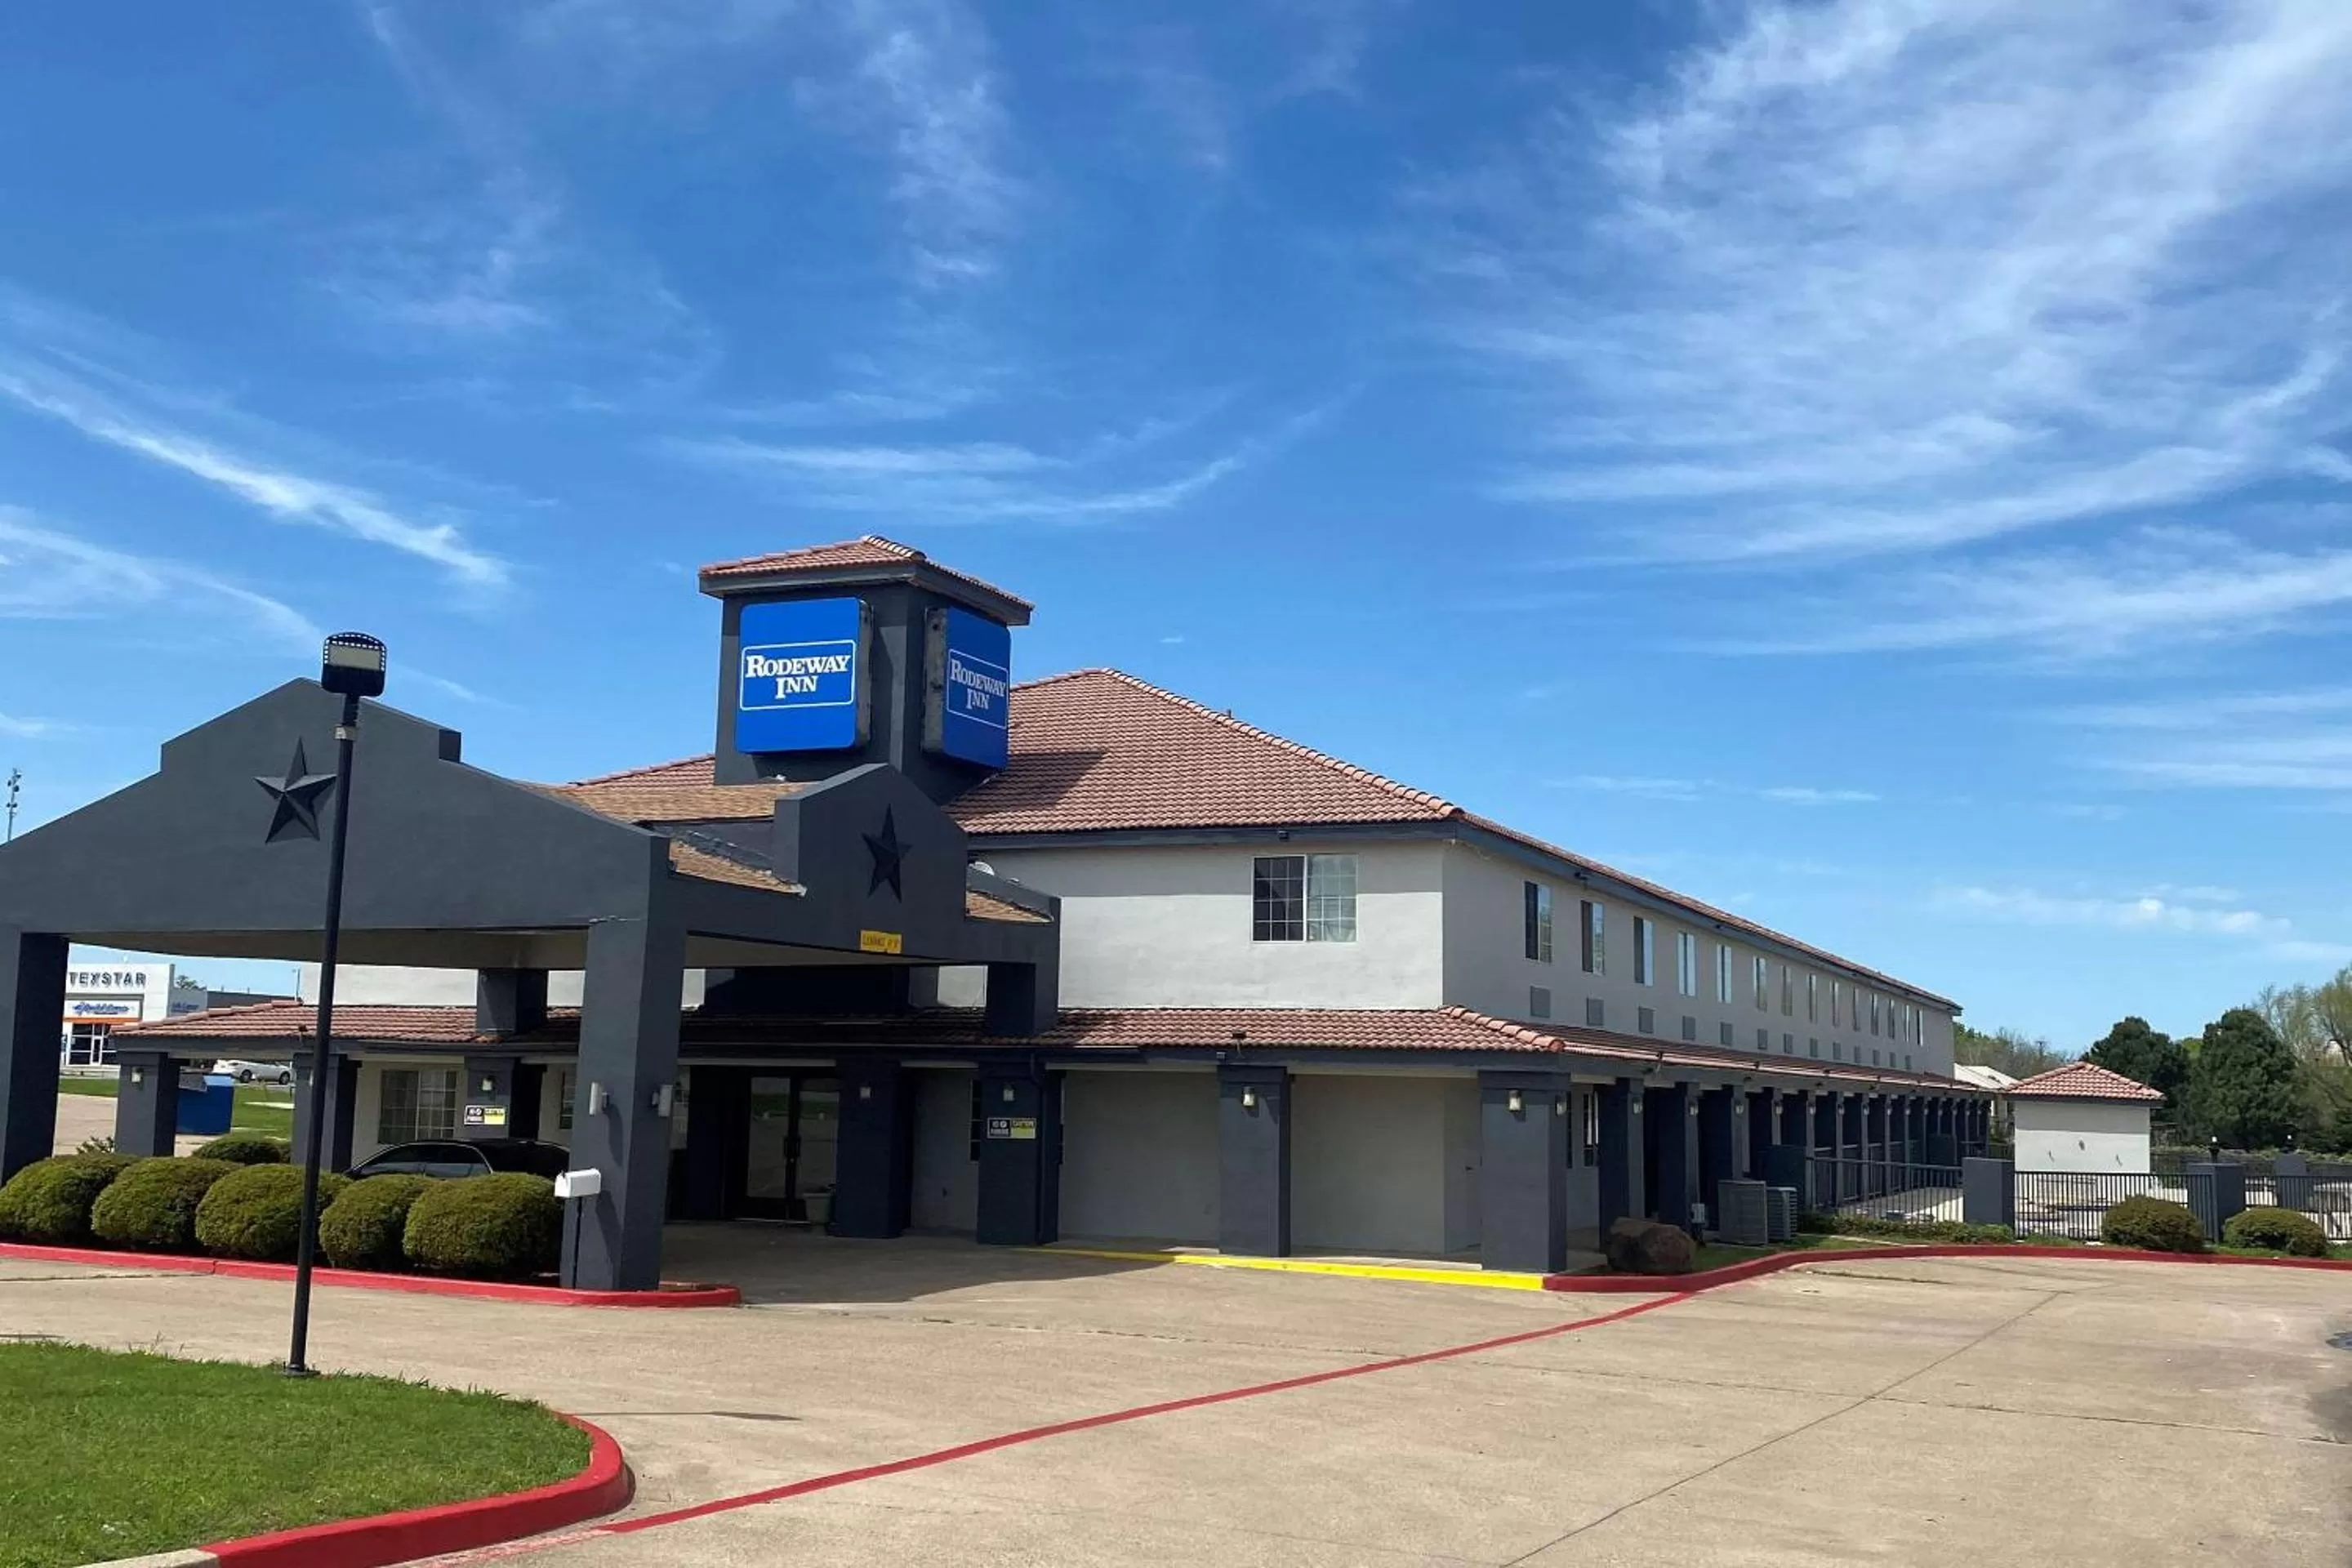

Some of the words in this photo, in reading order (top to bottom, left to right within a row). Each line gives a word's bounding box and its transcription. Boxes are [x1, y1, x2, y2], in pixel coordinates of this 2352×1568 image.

[745, 655, 851, 678] RODEWAY
[950, 658, 1006, 697] RODEWAY
[775, 675, 819, 699] INN
[966, 688, 990, 710] INN
[69, 971, 147, 987] TEXSTAR
